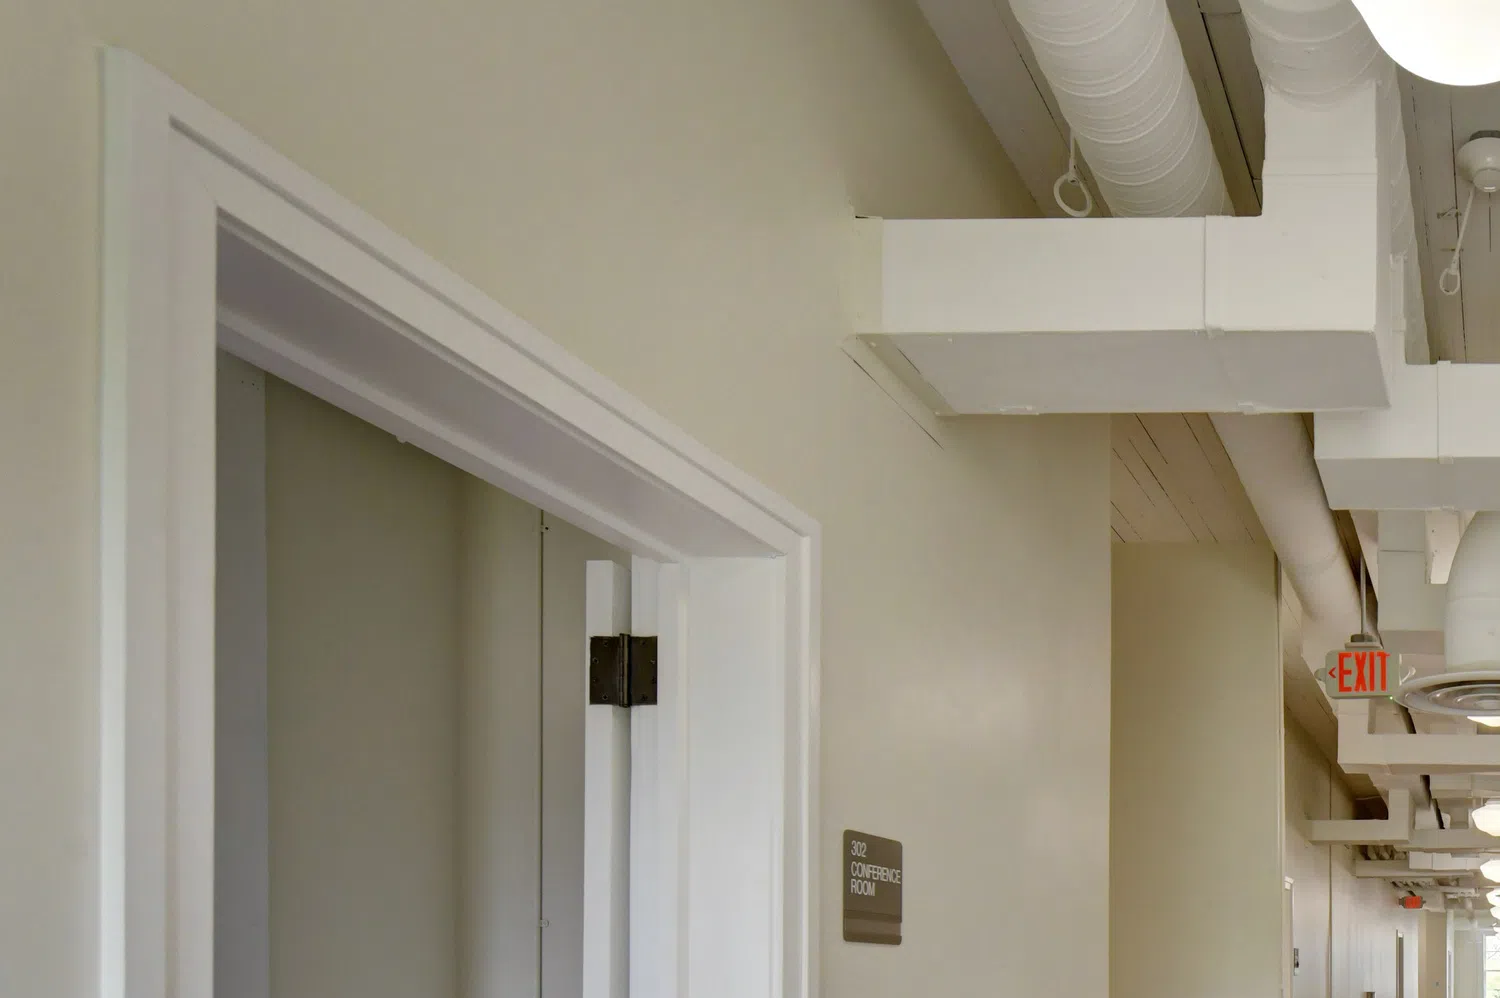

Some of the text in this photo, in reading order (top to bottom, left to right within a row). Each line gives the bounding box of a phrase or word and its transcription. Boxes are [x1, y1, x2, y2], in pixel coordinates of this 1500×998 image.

[1338, 650, 1391, 692] EXIT
[851, 840, 867, 857] 302
[851, 861, 901, 884] CONFERENCE
[850, 878, 876, 896] ROOM
